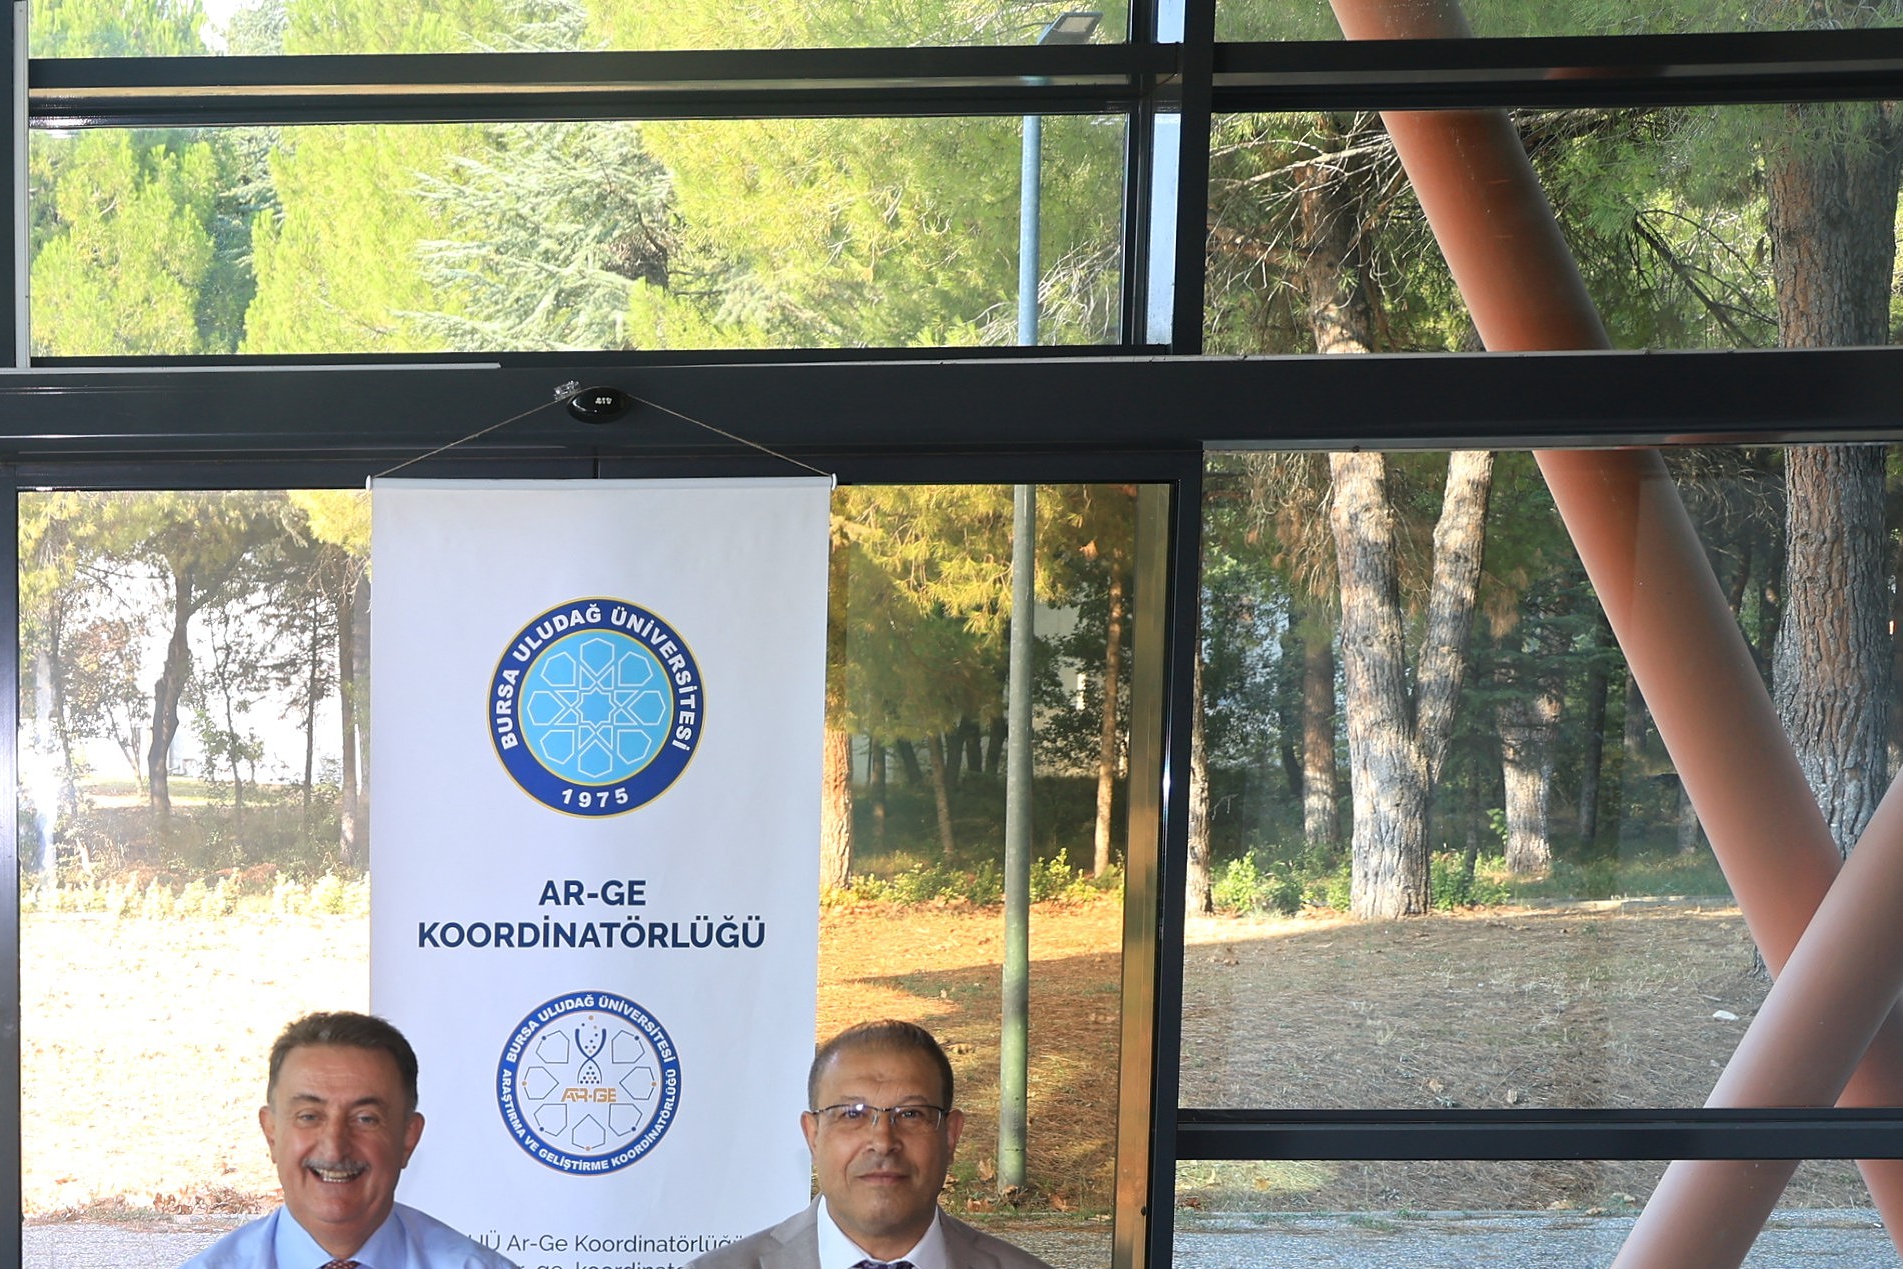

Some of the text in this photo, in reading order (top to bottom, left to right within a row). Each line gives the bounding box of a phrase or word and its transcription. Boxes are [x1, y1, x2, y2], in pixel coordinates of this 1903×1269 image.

[496, 603, 697, 751] BURSA ULUDAĞ ÜNİVERSİTESİ
[562, 787, 628, 807] 1975
[538, 880, 647, 906] AR-GE
[418, 915, 766, 949] KOORDİNATÖRLÜĞÜ
[506, 994, 676, 1063] BURSA ULUDAĞ ÜNİVERSİTESİ
[501, 1069, 676, 1171] ARAŞTIRMA VE GELİŞTİRME KOORDİNATÖRLÜĞÜ
[506, 1234, 568, 1252] Ar-Ge
[575, 1234, 744, 1253] Koordinatörlüğ
